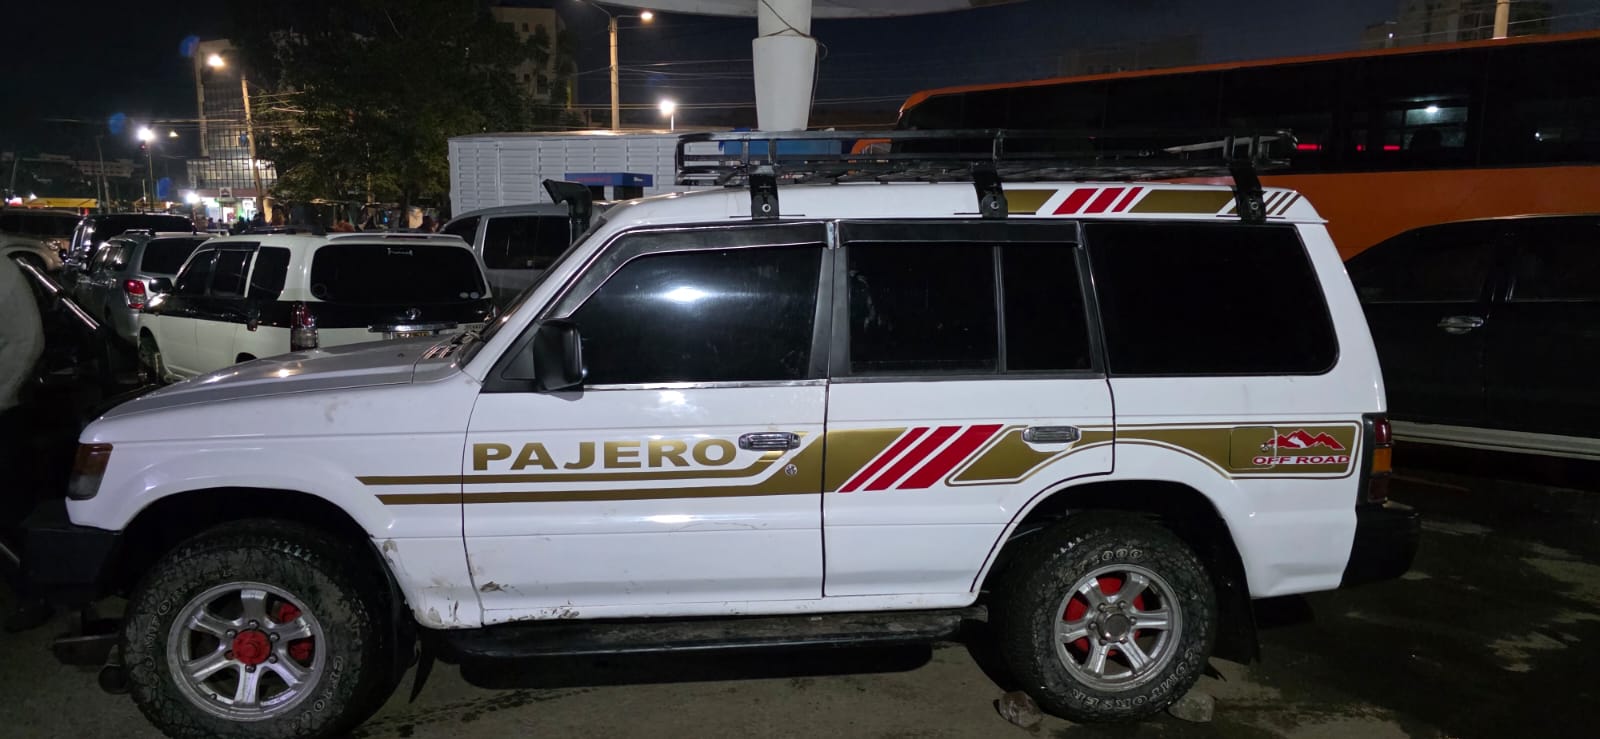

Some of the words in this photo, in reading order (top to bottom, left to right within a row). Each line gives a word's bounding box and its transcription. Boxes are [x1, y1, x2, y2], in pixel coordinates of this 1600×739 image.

[472, 438, 737, 471] PAJERO
[1252, 455, 1291, 465] OFF
[1294, 454, 1350, 465] ROAD
